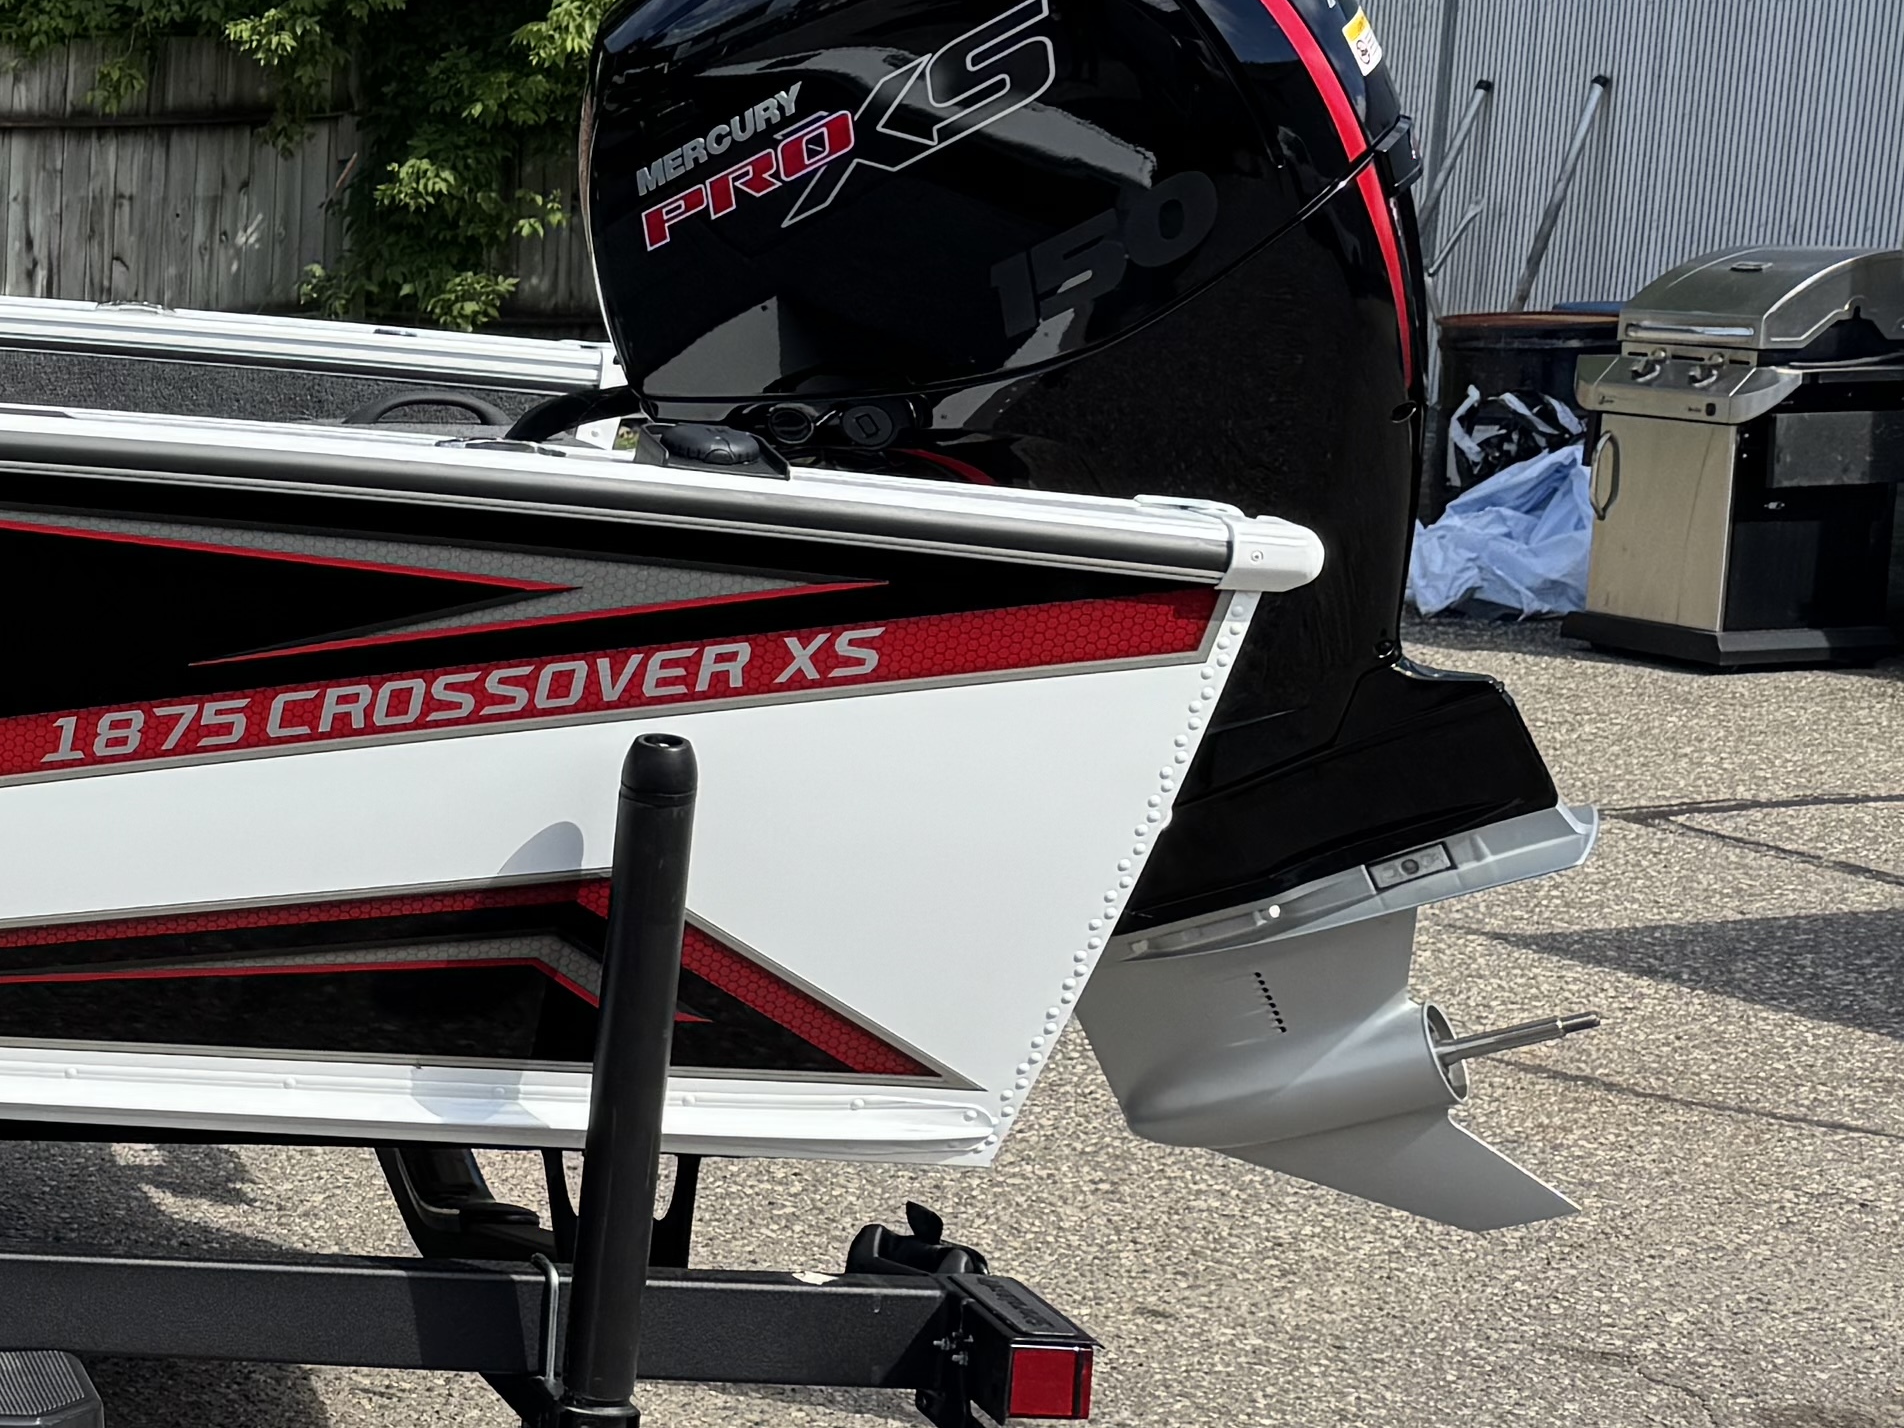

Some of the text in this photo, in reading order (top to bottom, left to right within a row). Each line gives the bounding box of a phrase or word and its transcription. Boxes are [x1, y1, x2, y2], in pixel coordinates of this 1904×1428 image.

[636, 81, 803, 196] MERCURY
[641, 110, 855, 252] PRO
[992, 171, 1218, 340] 150
[39, 626, 888, 764] 1875 CROSSOVER XS
